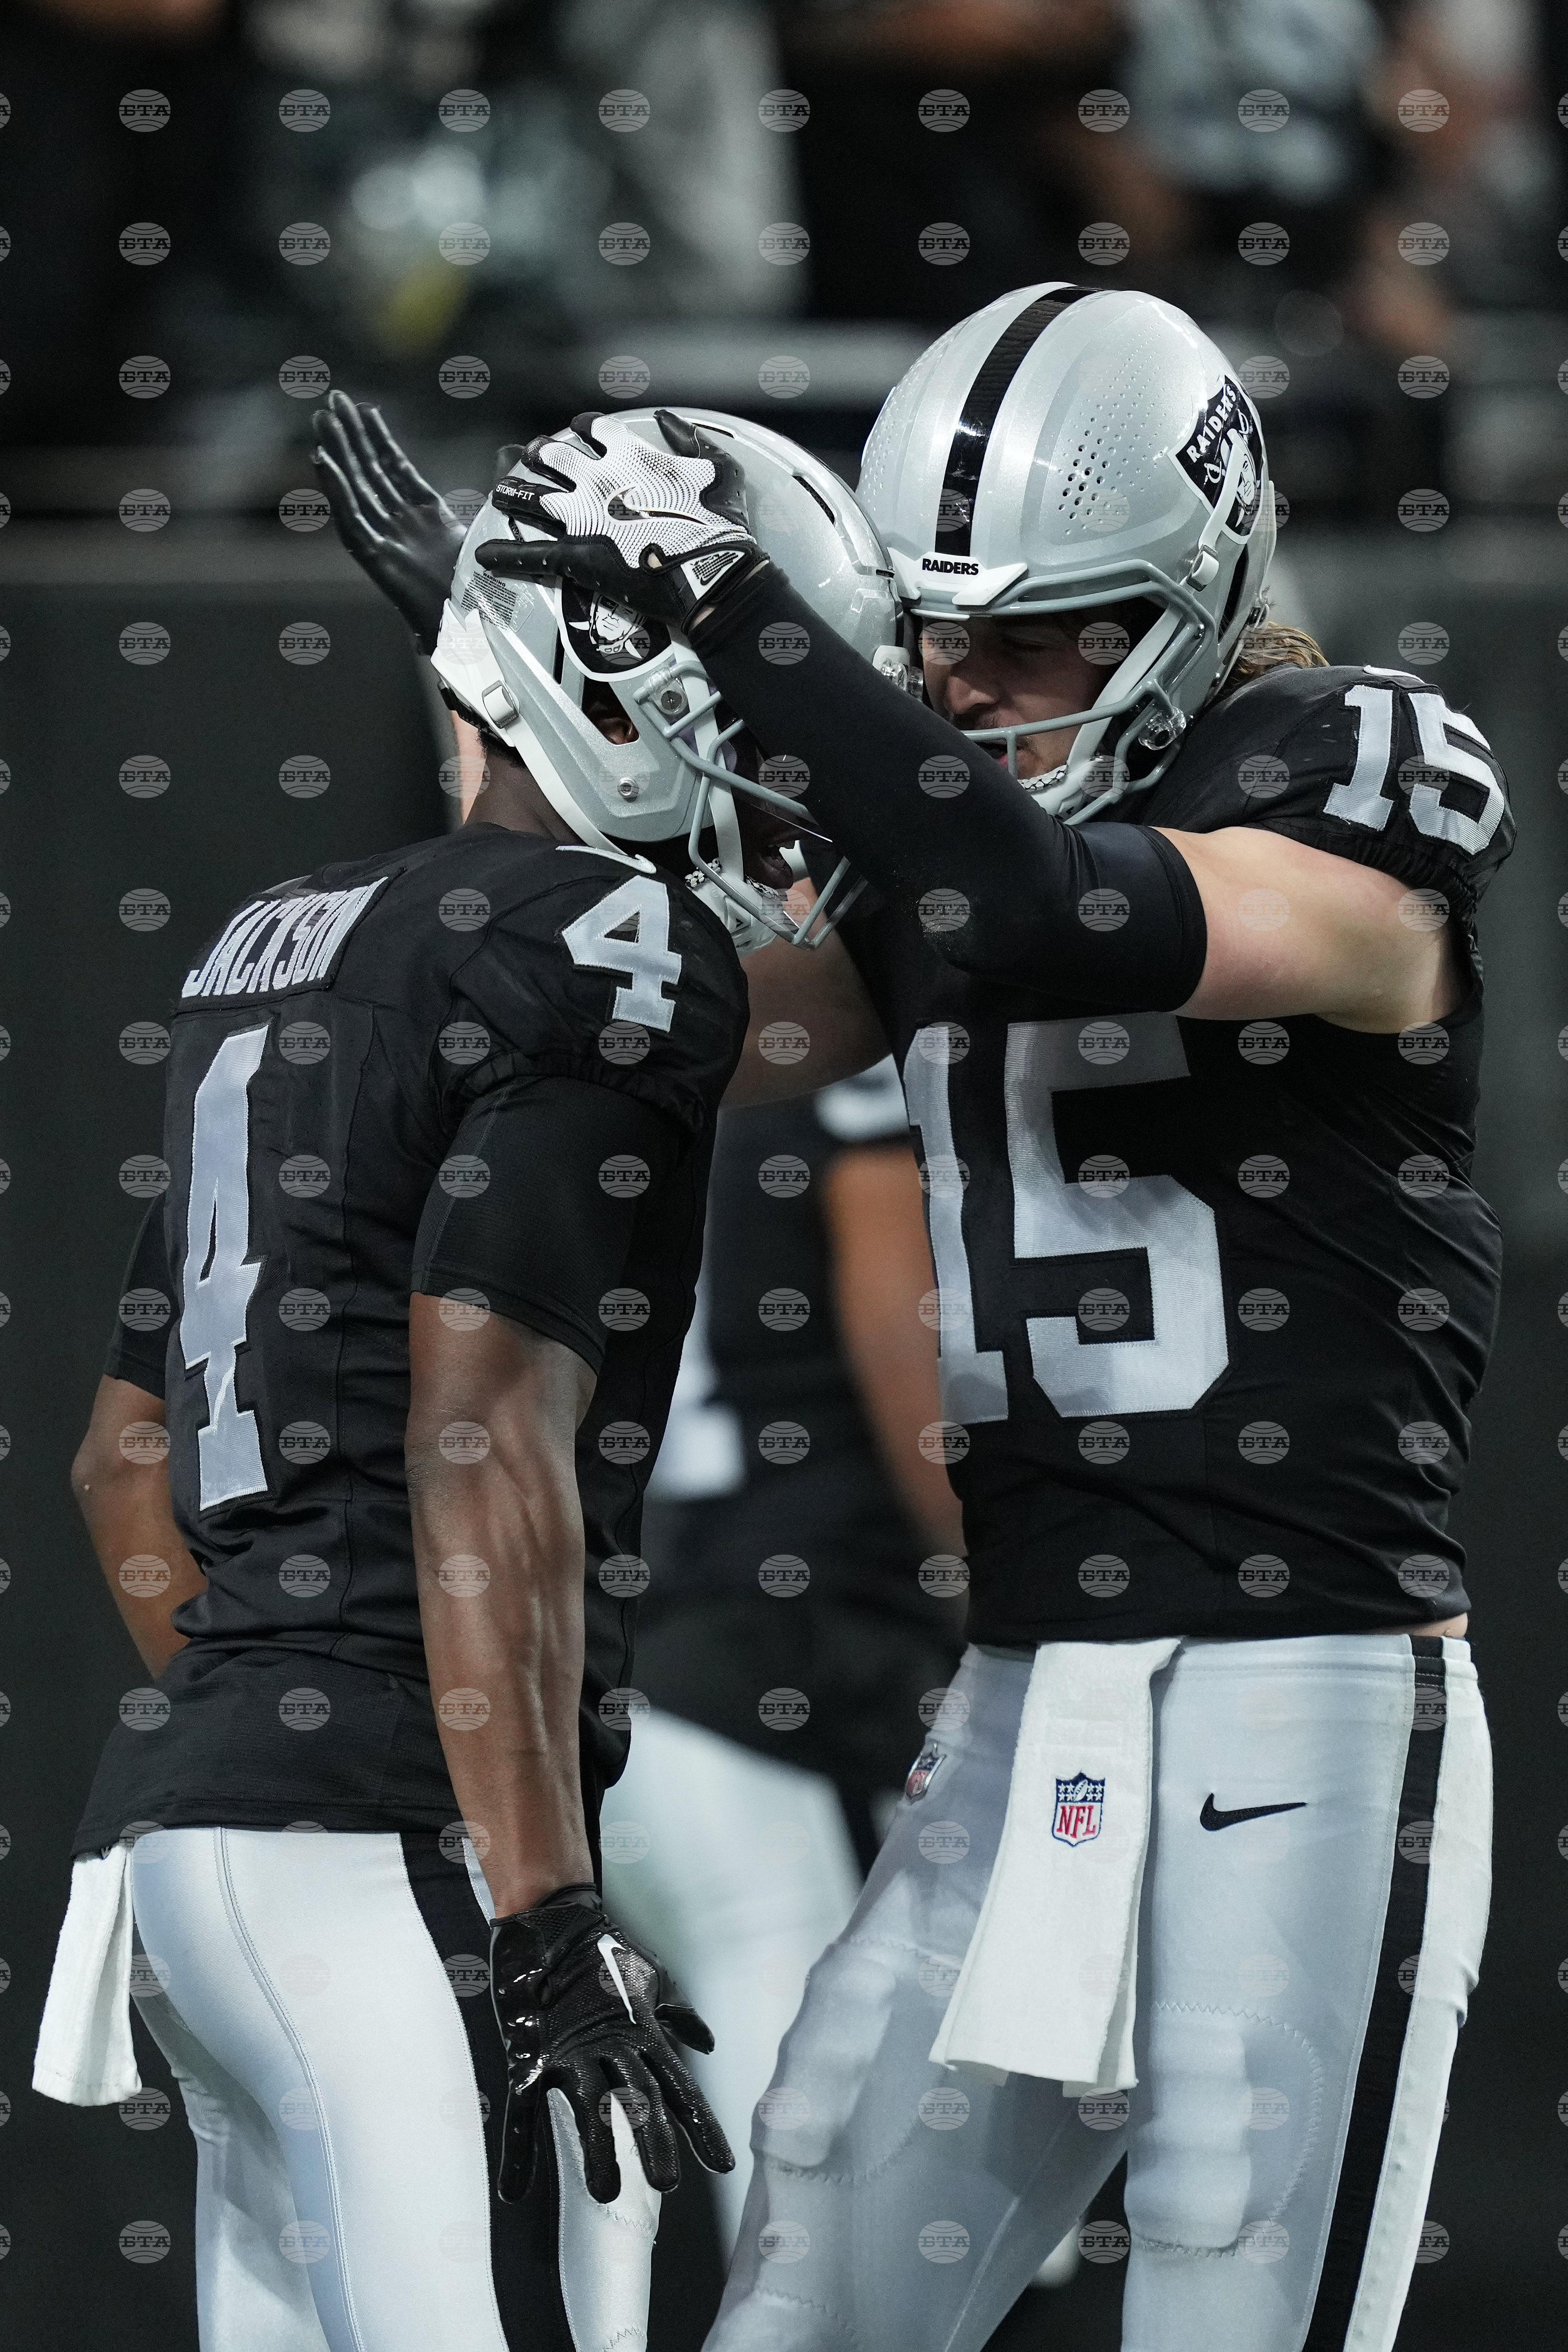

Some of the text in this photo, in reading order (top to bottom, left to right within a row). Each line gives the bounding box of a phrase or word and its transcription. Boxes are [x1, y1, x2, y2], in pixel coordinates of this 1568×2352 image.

[1187, 385, 1236, 463] RAIDERS
[496, 484, 535, 500] STORM-FIT
[483, 572, 506, 587] WARNING
[922, 558, 979, 575] RAIDERS
[1323, 685, 1504, 855] 15
[182, 877, 388, 998] JACKSON
[562, 875, 682, 1032] 4
[180, 1024, 268, 1511] 4
[903, 1011, 1229, 1425] 15
[1056, 1805, 1096, 1839] NFL
